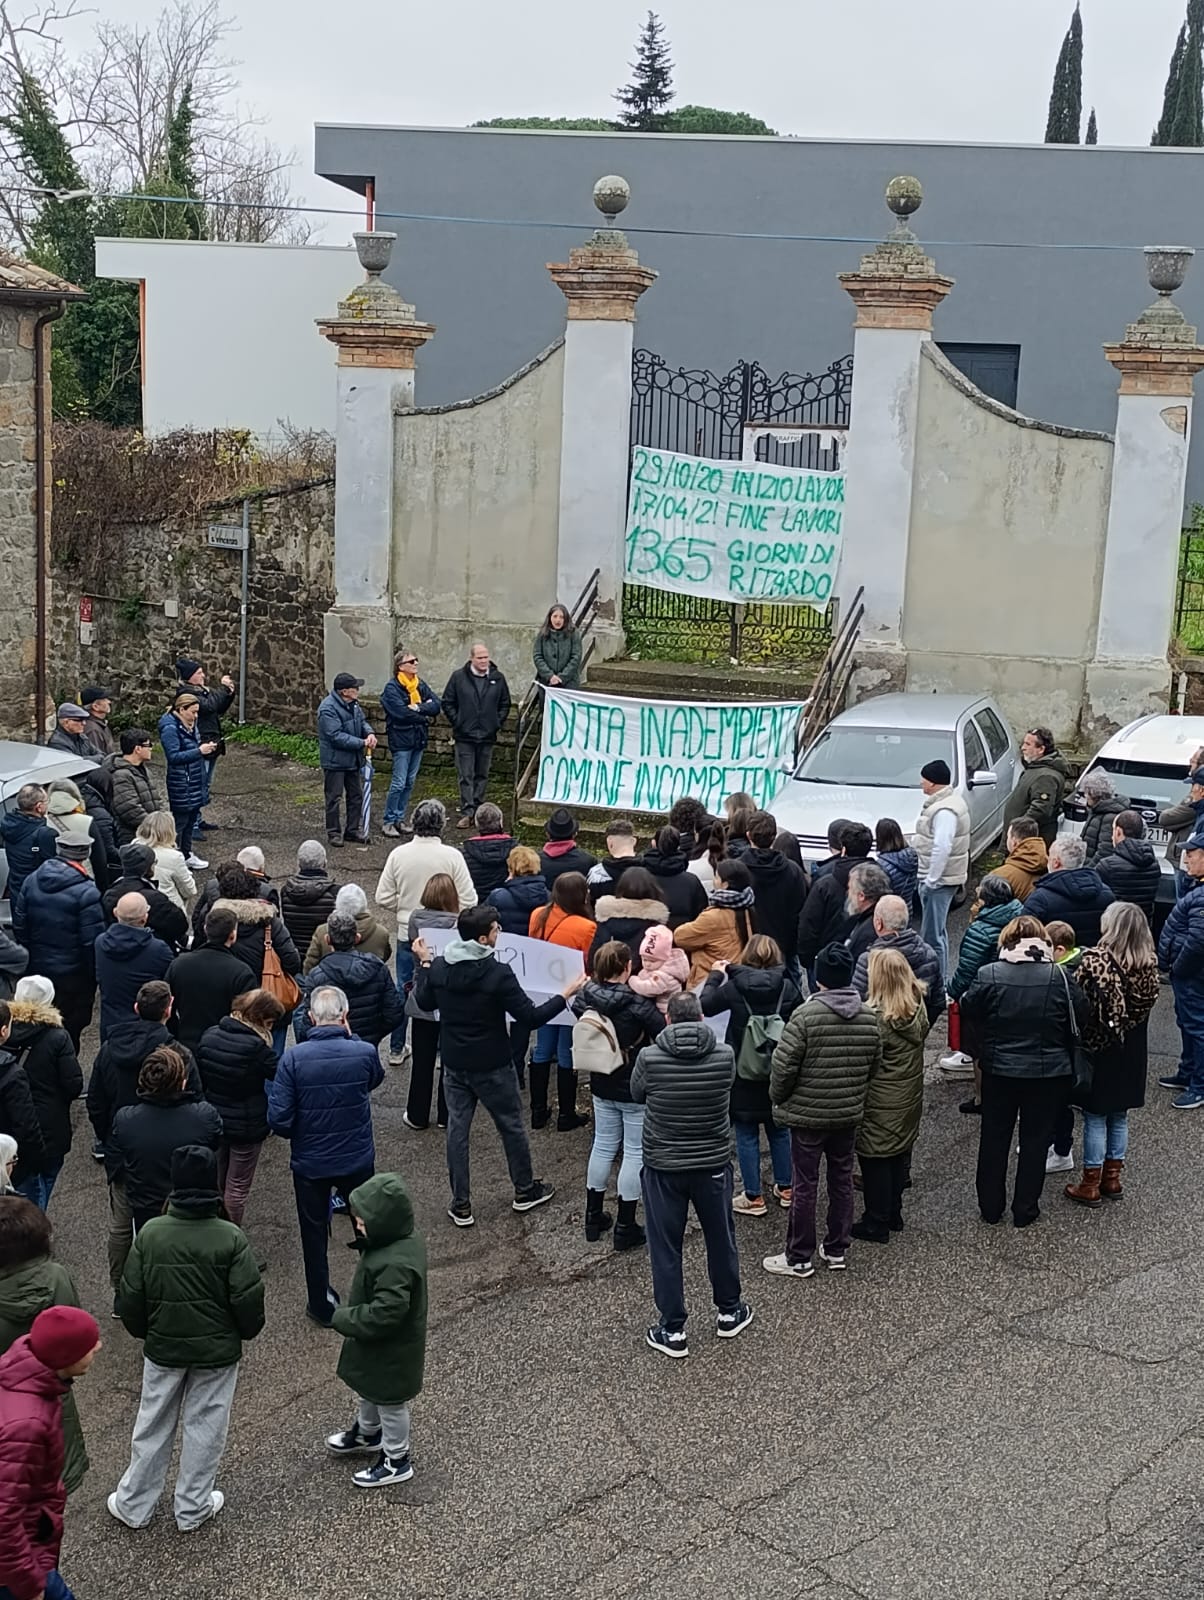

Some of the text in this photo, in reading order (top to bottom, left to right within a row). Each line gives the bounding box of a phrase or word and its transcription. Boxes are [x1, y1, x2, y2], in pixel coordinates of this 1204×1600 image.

[635, 451, 845, 503] 29/10/20 INIZIO LAVOR
[726, 502, 775, 532] FINE
[781, 507, 842, 534] LAVORI
[625, 525, 834, 582] 1365 GIORNI DI
[729, 564, 832, 600] RITARDO
[550, 699, 802, 760] DITTA INADEMPIENT
[538, 755, 789, 813] COMUNE INCOMPETENT
